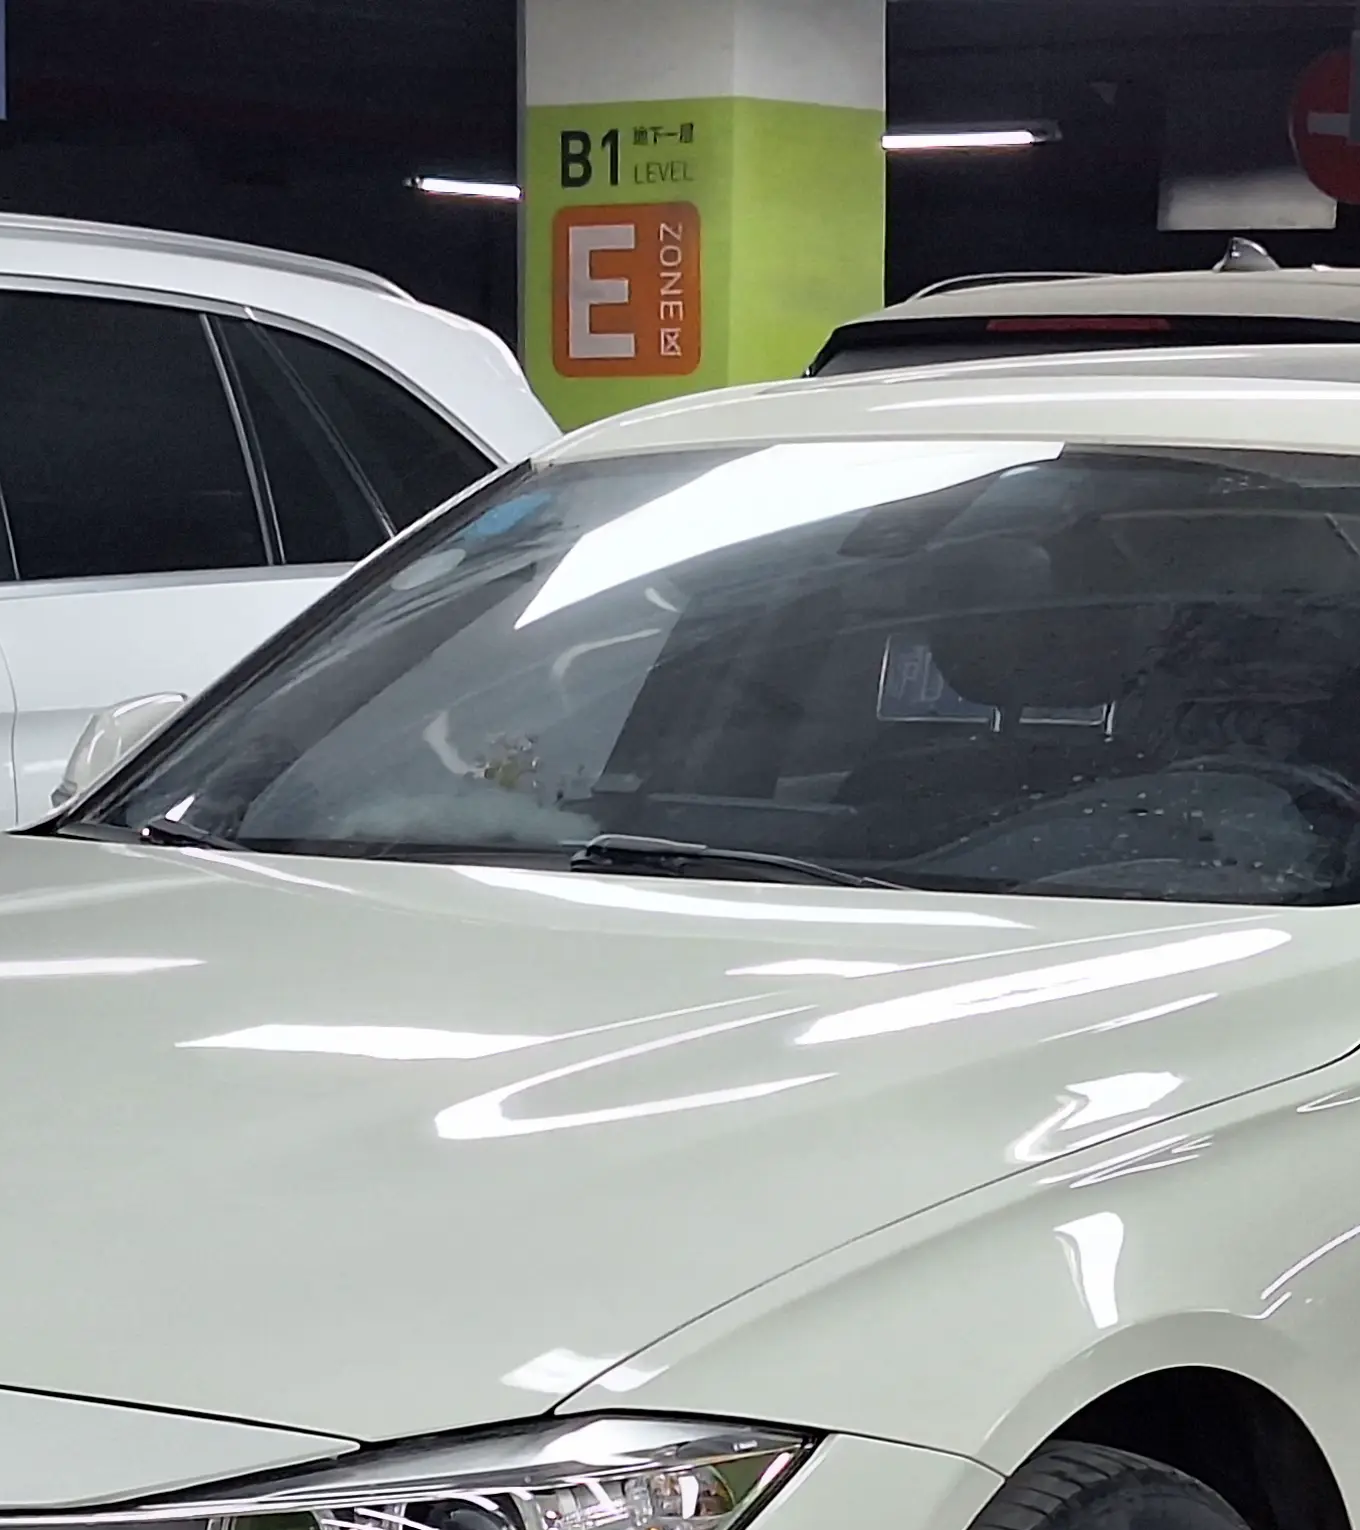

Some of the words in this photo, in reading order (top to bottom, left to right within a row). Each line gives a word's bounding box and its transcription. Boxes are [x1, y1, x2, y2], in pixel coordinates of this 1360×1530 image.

[559, 128, 621, 189] B1
[633, 161, 694, 185] LEVEL
[568, 223, 636, 359] E
